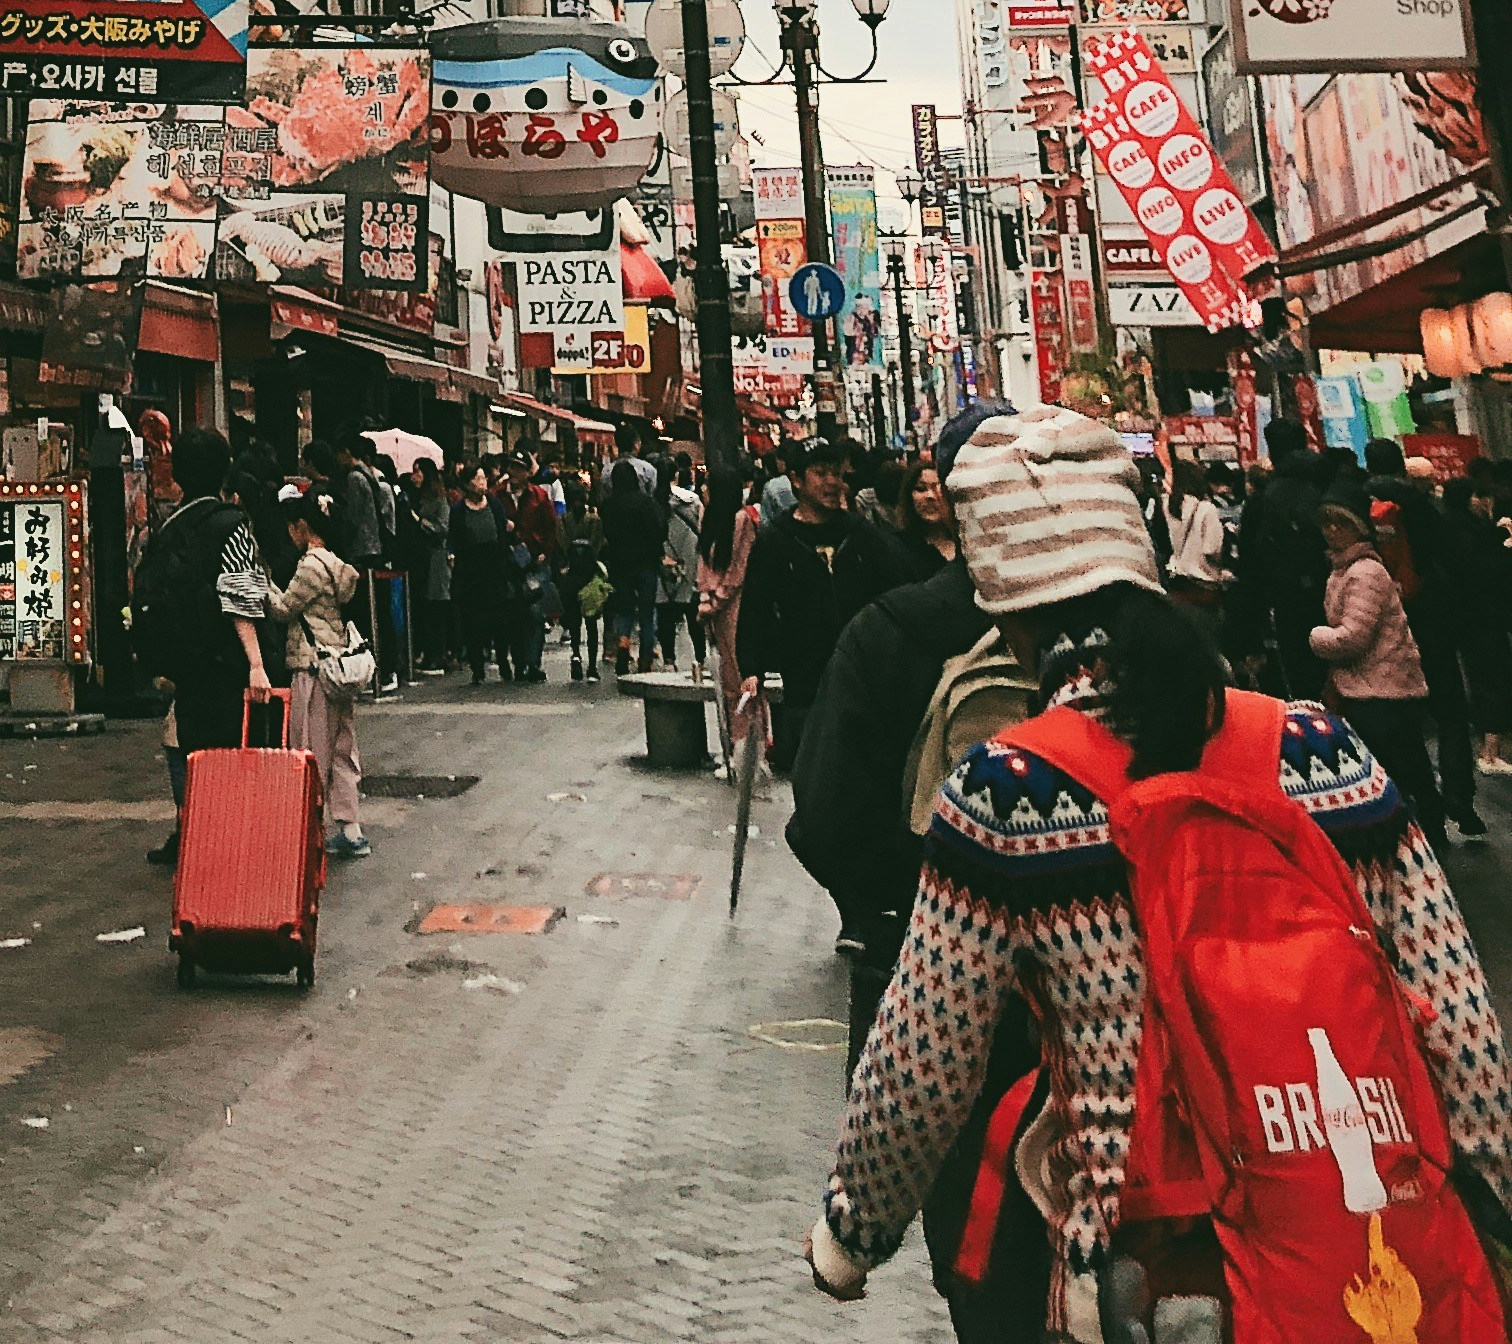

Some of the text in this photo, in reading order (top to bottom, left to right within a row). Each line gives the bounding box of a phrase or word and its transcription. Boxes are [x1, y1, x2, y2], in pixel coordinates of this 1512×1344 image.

[114, 65, 159, 96] 선물
[1129, 88, 1171, 120] CAFE
[149, 123, 278, 153] 海鮮居酒屋
[430, 111, 619, 160] づぼらや
[1112, 147, 1148, 173] CAFE
[1162, 143, 1204, 176] INFO
[1141, 194, 1177, 221] INFO
[1199, 197, 1237, 227] LIVE
[1171, 242, 1203, 269] LIVE
[524, 261, 616, 286] PASTA
[560, 286, 577, 301] &
[529, 300, 617, 326] PIZZA
[593, 340, 623, 360] 2F
